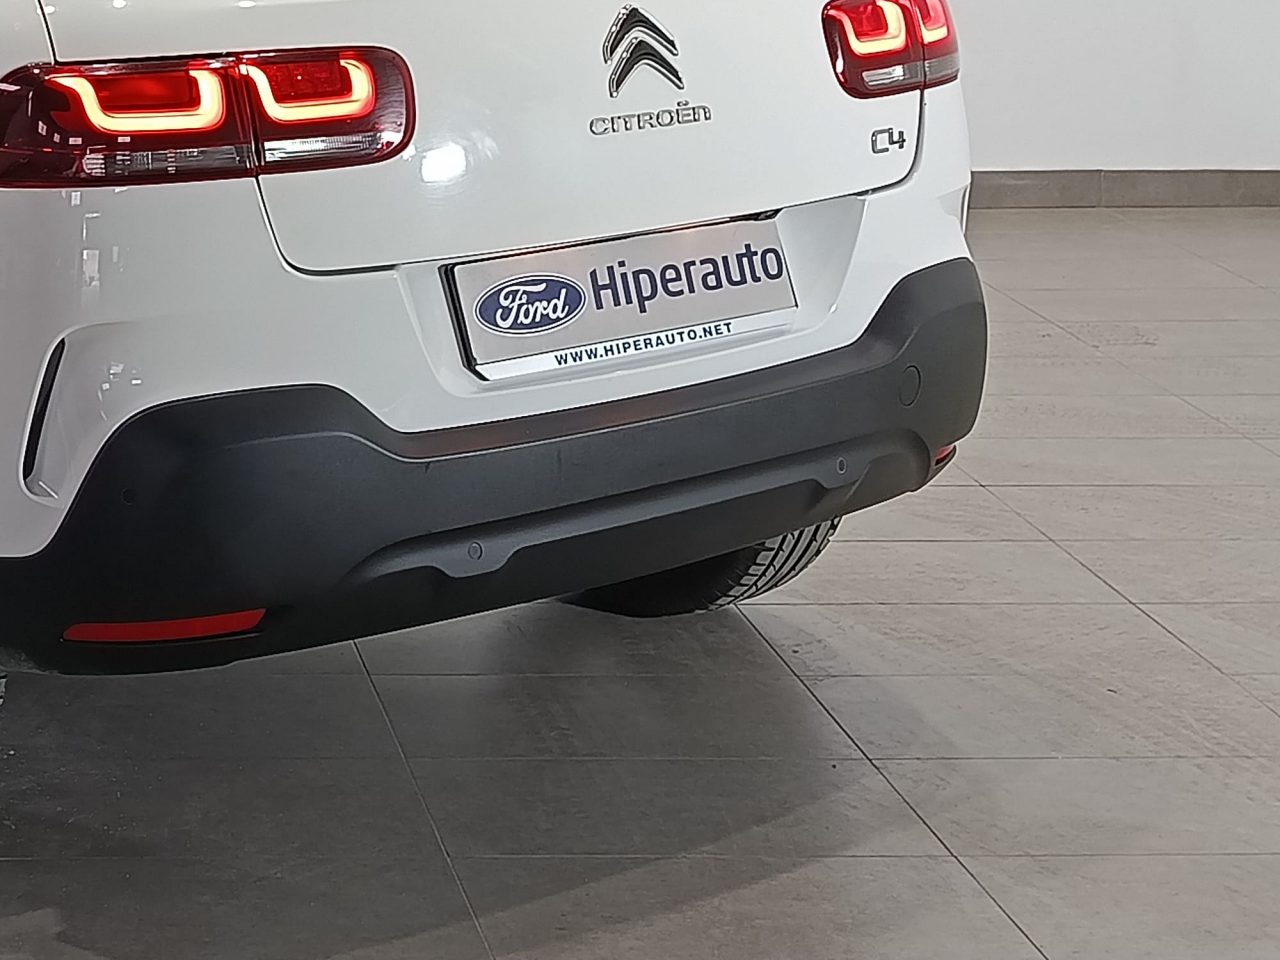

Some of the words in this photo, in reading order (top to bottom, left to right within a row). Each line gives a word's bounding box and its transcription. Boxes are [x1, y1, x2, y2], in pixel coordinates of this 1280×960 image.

[871, 127, 907, 154] C4
[495, 281, 570, 329] Ford
[589, 243, 784, 314] Hiperauto
[554, 322, 734, 366] WWW.HIPERAUTO.NET
